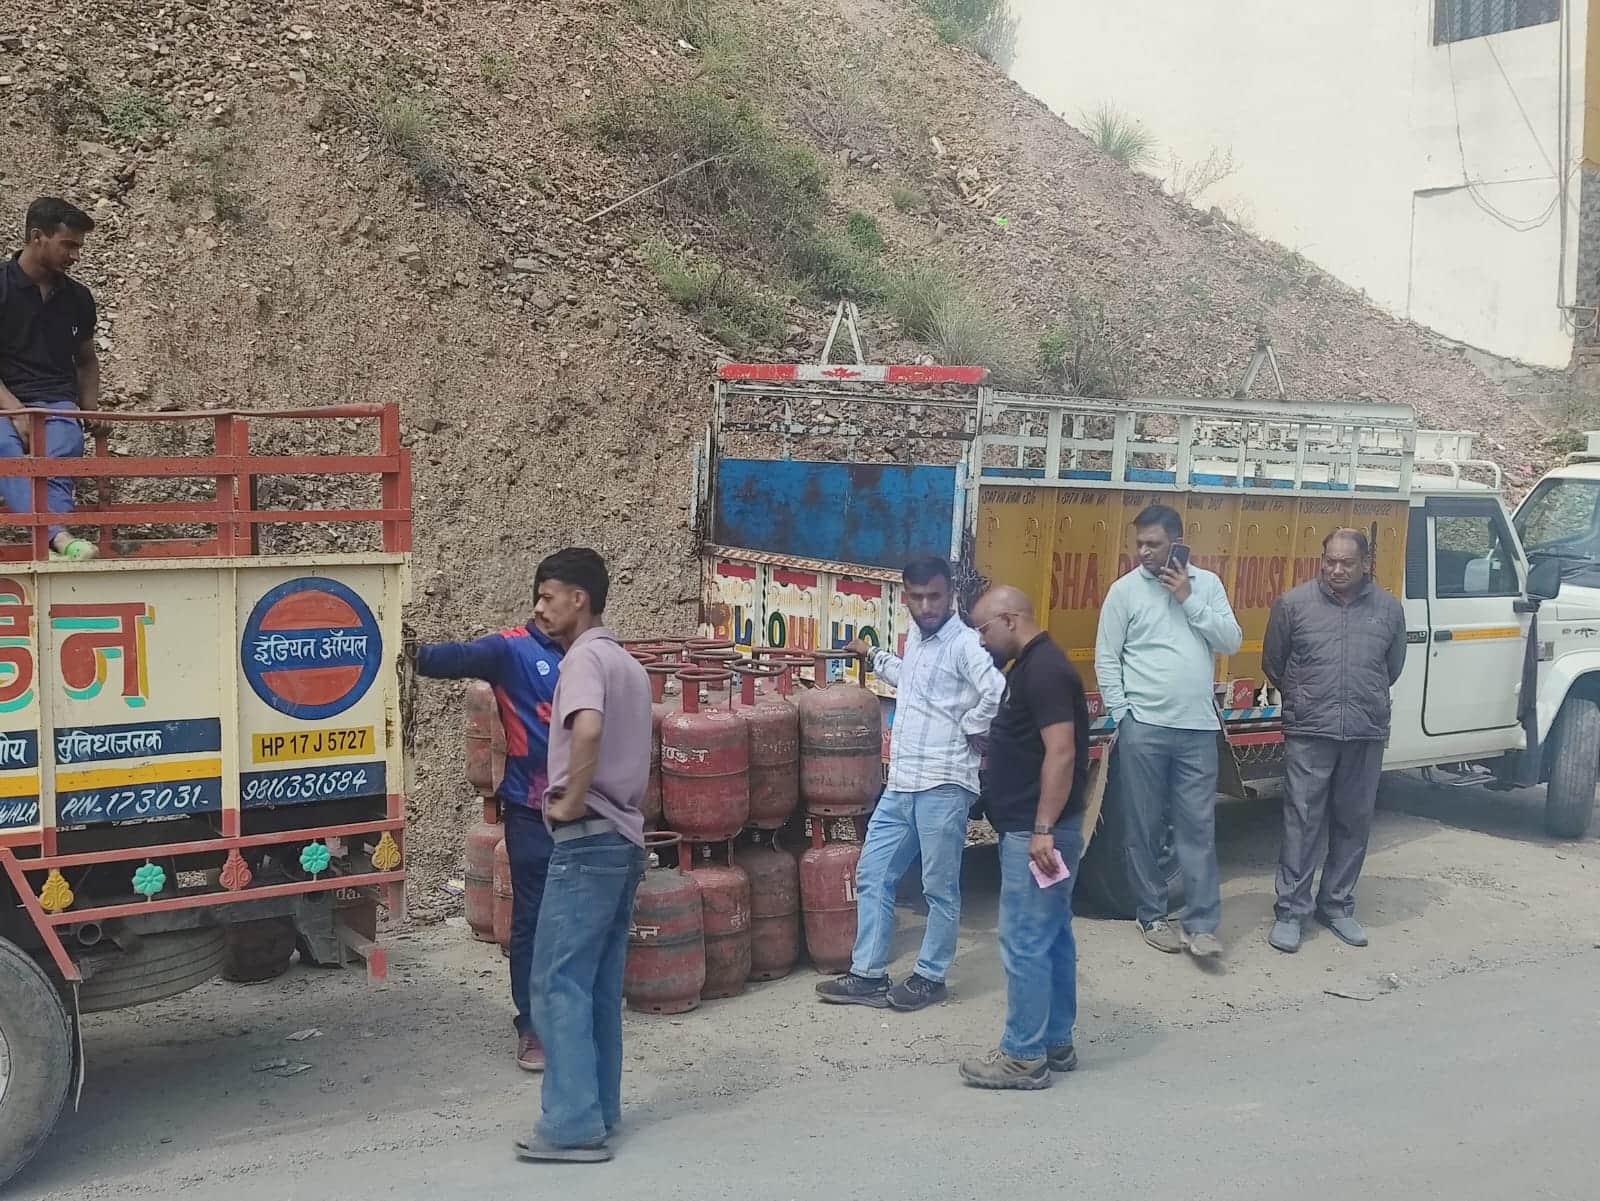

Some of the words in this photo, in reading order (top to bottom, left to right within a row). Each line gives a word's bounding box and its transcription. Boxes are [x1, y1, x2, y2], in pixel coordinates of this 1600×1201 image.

[253, 634, 315, 666] इंडियन
[320, 629, 368, 660] ऑयल
[57, 730, 162, 763] सुविधाजनक
[261, 736, 285, 757] HP
[290, 735, 309, 755] 17
[313, 732, 323, 752] J
[327, 730, 367, 751] 5727
[242, 769, 368, 800] 9816331584
